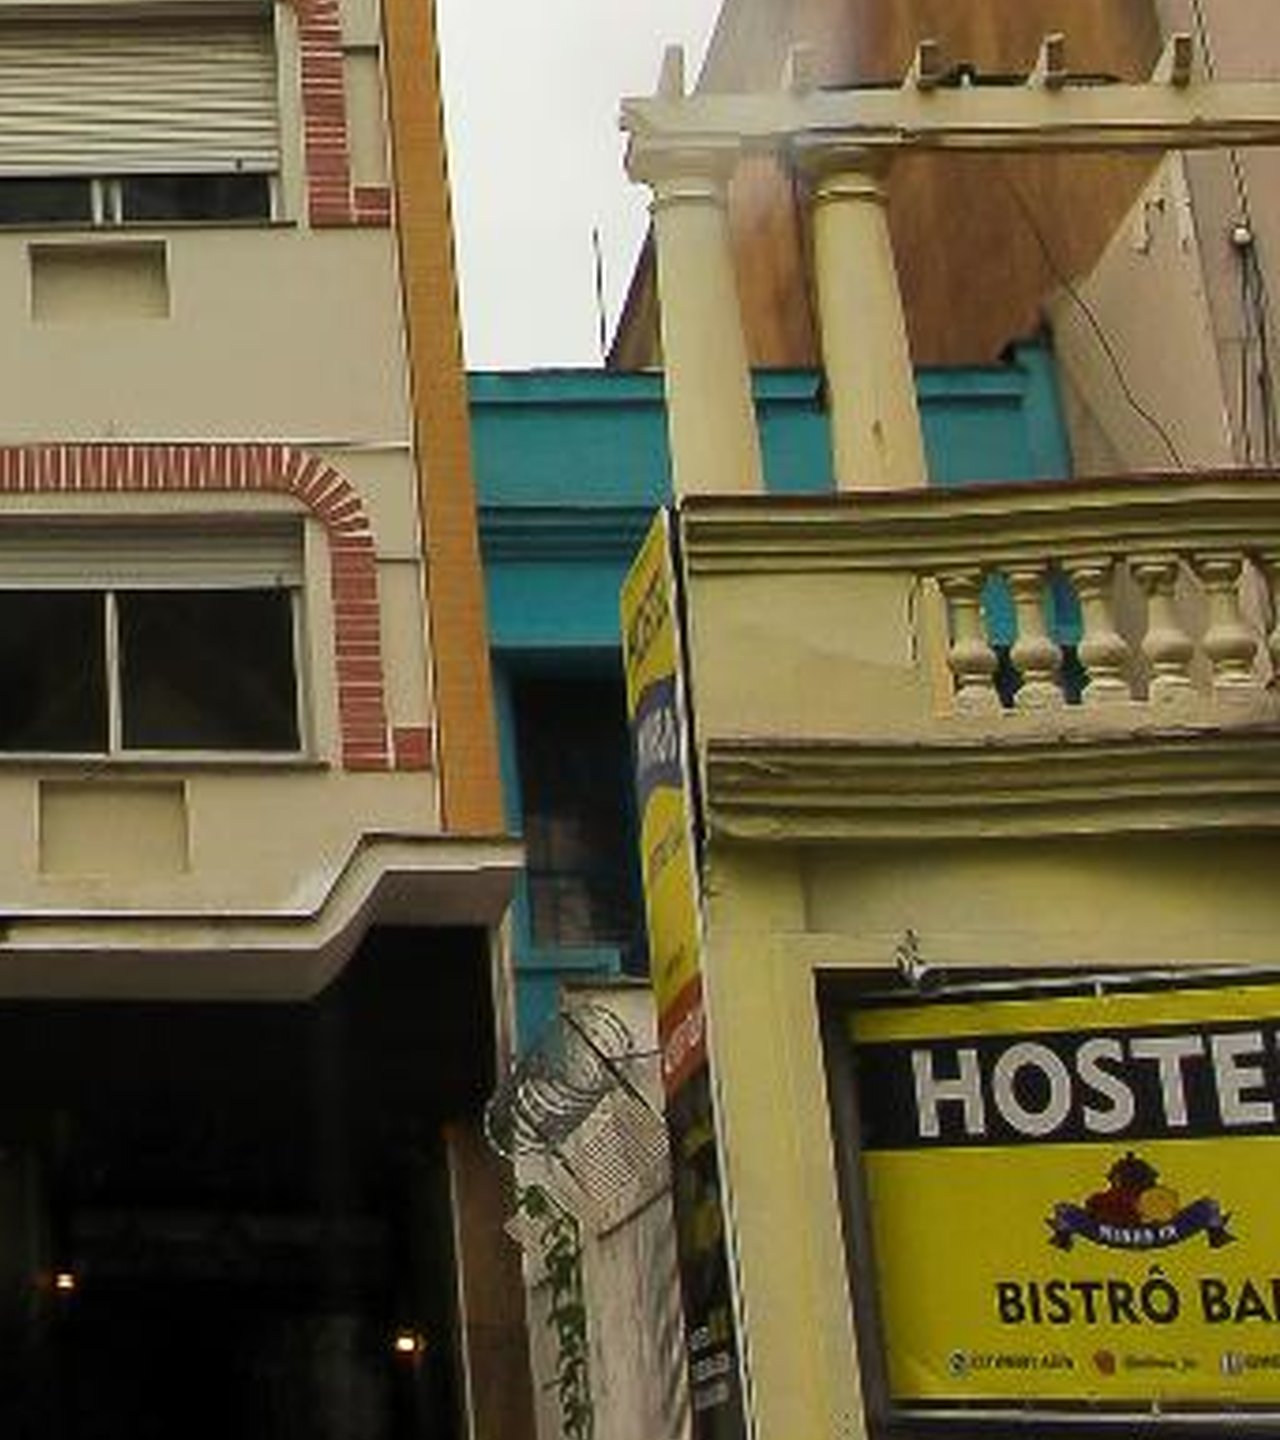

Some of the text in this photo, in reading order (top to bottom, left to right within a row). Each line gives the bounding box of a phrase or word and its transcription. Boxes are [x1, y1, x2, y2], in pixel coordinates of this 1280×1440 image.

[911, 1031, 1280, 1138] HOSTE
[996, 1264, 1280, 1324] BISTRÔ BA
